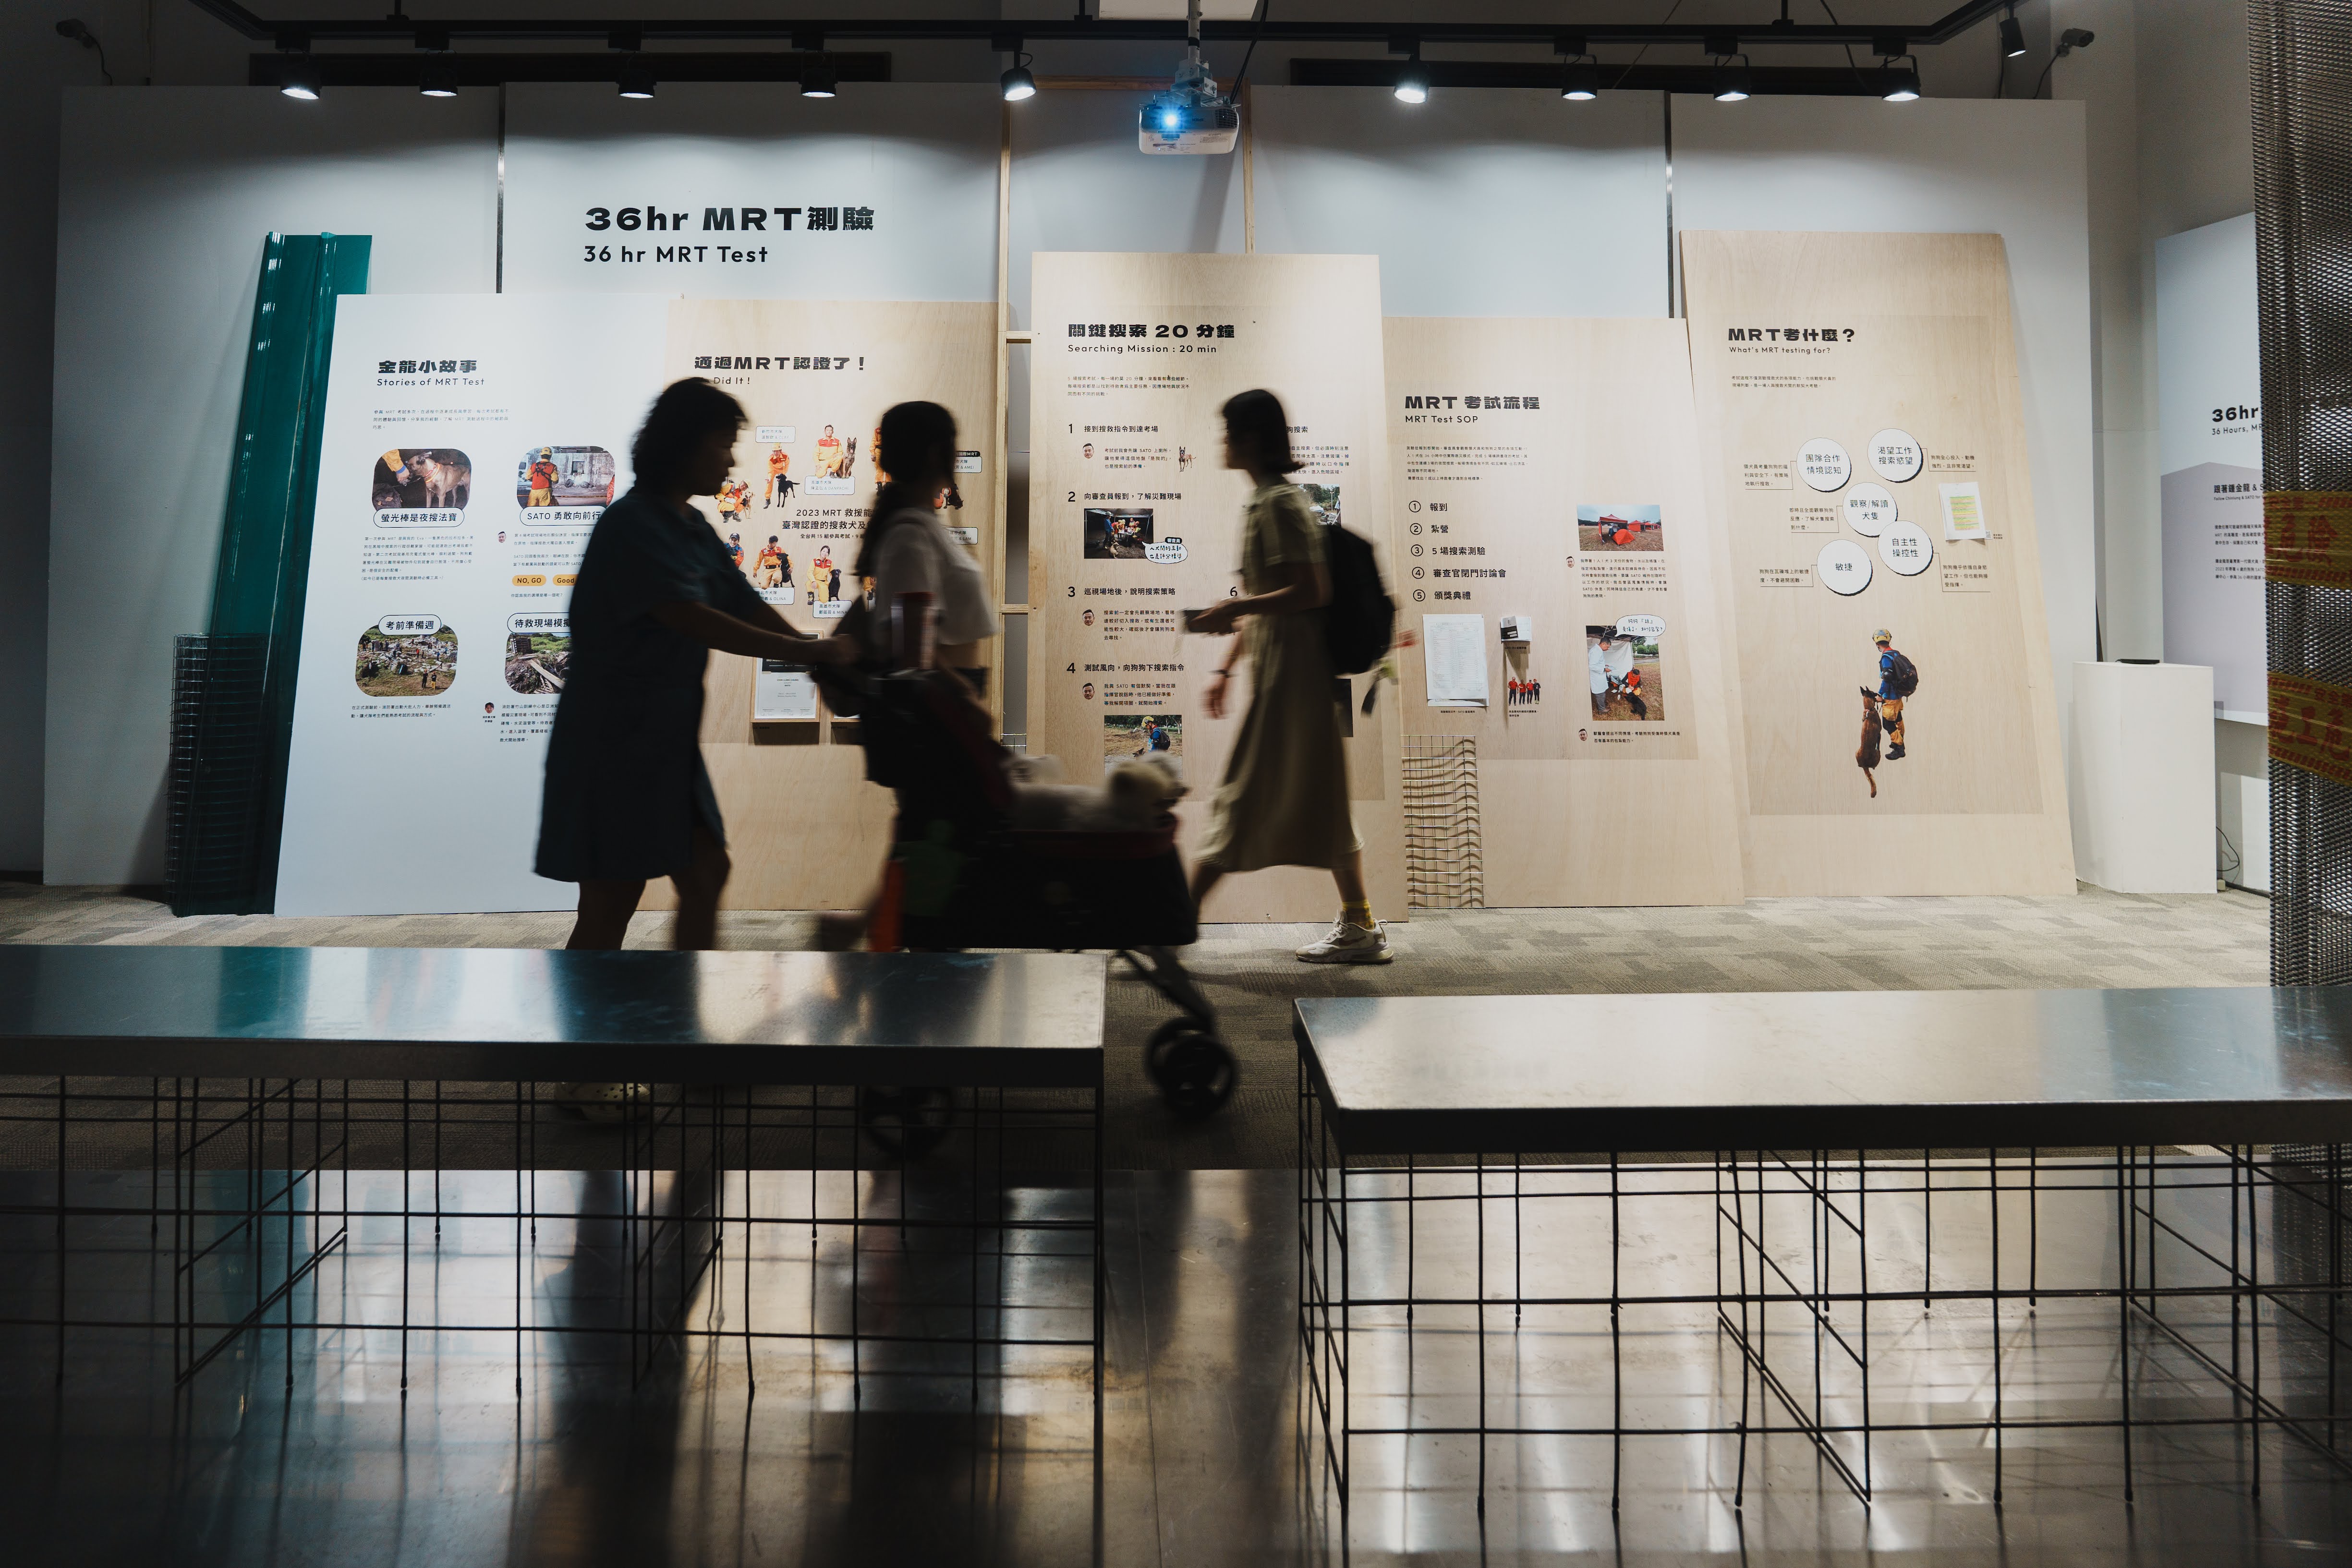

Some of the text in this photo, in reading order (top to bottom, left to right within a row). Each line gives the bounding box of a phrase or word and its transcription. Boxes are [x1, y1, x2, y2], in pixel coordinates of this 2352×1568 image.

[585, 206, 874, 231] 36hr MRT測驗
[584, 246, 768, 262] 36 hr MRT Test
[1068, 324, 1235, 338] 關鍵搜索 20 分鐘
[1068, 344, 1217, 354] Searching Mission 20 min
[1782, 347, 1810, 355] testing
[378, 360, 477, 374] 金龍小故事
[377, 378, 415, 386] Stories
[420, 377, 431, 386] of
[463, 377, 485, 386] Test
[1405, 396, 1540, 410] MRT 考試流程
[2212, 405, 2258, 422] 36hr
[1457, 415, 1478, 423] SOP
[1068, 423, 1072, 434] 1
[1878, 446, 1912, 455] 渴望工作
[1806, 454, 1840, 463] 團隊合作
[1879, 456, 1913, 465] 搜索慾望
[1806, 466, 1842, 475] 情境認知
[1068, 492, 1075, 502] 2
[1430, 502, 1447, 512] 報到
[1850, 499, 1889, 508] 觀察/解讀
[381, 512, 457, 523] 螢光棒是夜搜法寶
[527, 510, 602, 521] SATO 勇敢向前行
[1862, 511, 1879, 520] 犬隻
[782, 521, 869, 529] 臺灣認證的搜救犬及
[1431, 524, 1449, 534] 紮營
[1892, 538, 1917, 546] 自主性
[1432, 546, 1486, 556] 5 場搜索測驗
[1892, 549, 1919, 557] 操控性
[1835, 563, 1853, 571] 敏捷
[1433, 568, 1506, 578] 審查官閉門討論會
[1068, 587, 1176, 597] 3 巡視場地後，說明搜索策略
[1230, 586, 1237, 597] 6
[1434, 591, 1471, 600] 頒獎典禮
[386, 620, 434, 631] 考前準備週
[1067, 663, 1076, 674] 4
